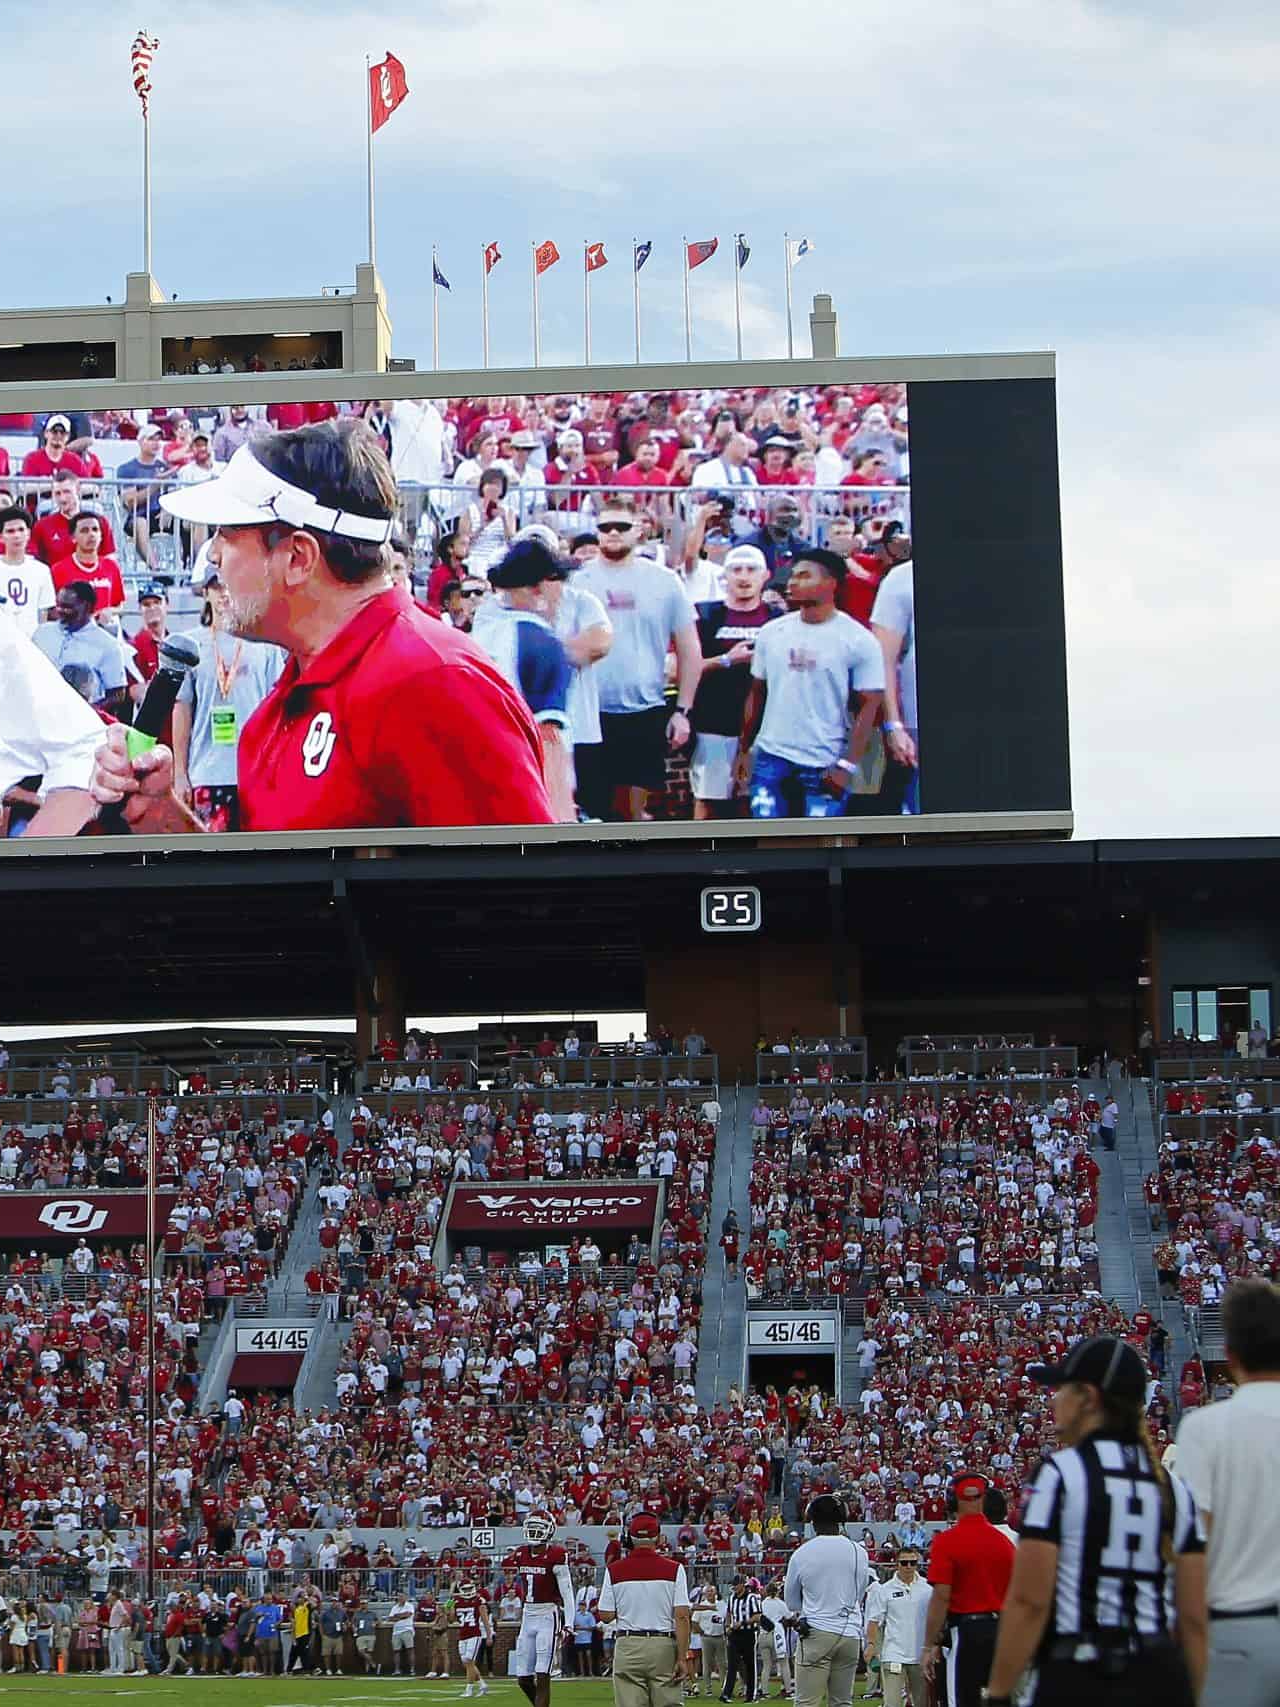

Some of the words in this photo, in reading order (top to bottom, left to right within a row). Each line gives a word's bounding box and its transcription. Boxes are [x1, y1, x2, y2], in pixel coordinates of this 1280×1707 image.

[8, 578, 28, 606] OU
[302, 711, 337, 777] OU
[712, 894, 751, 923] 25
[486, 1208, 618, 1218] CHAMPIONS
[528, 1196, 642, 1208] Valero
[38, 1200, 109, 1233] OU
[251, 1330, 308, 1350] 44/45
[765, 1322, 821, 1342] 45/46
[1101, 1475, 1162, 1572] H
[473, 1531, 491, 1546] 45
[525, 1574, 535, 1603] 1
[455, 1607, 475, 1627] 34
